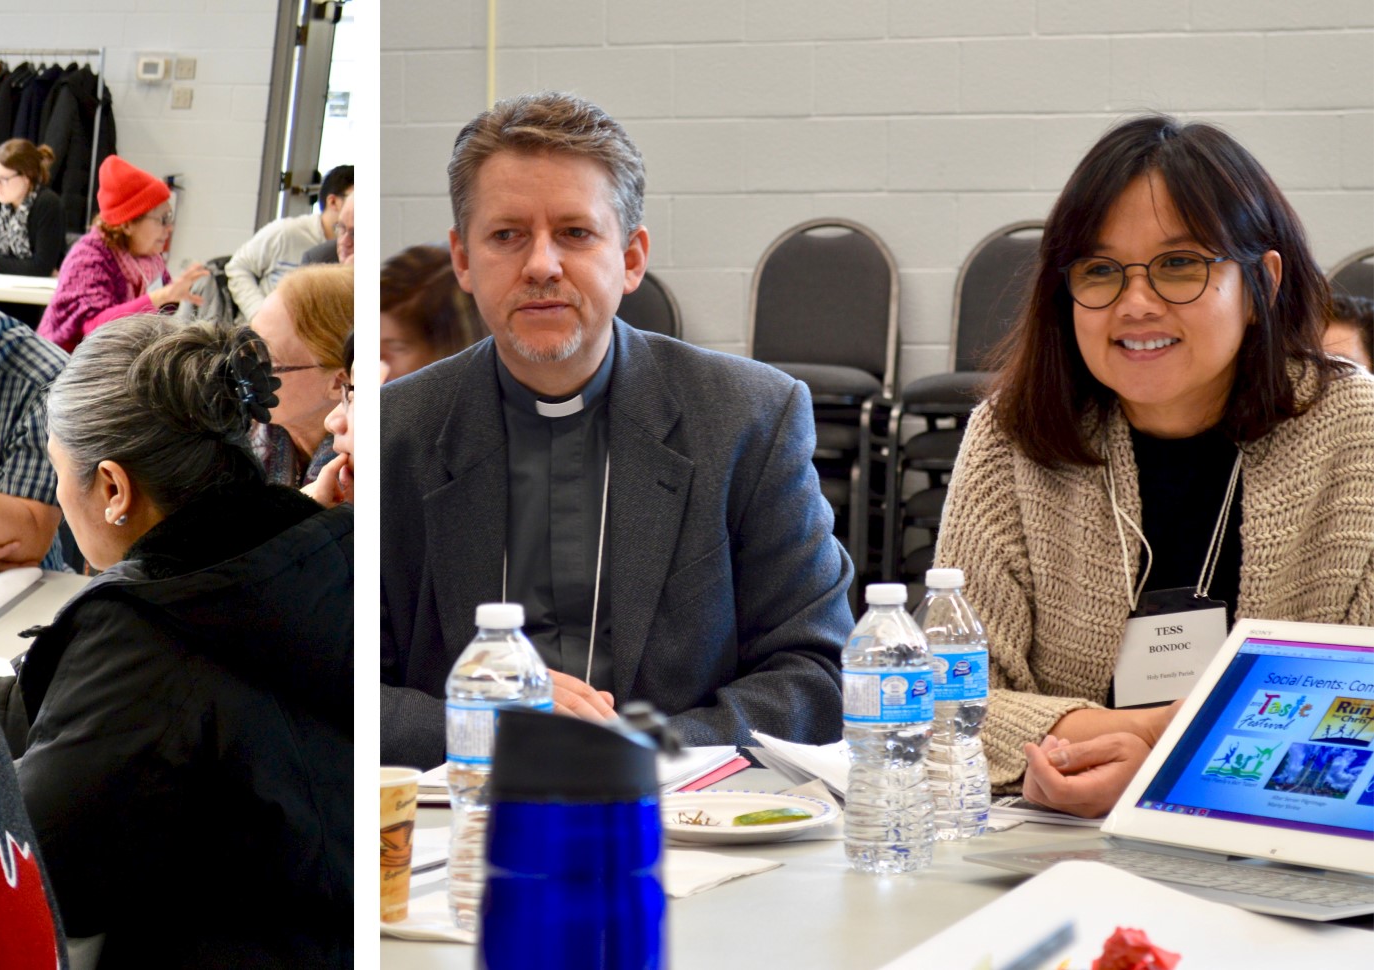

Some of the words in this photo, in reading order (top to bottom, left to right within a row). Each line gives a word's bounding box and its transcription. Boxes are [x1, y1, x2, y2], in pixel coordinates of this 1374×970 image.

[1155, 625, 1184, 637] TESS
[1149, 642, 1192, 654] BONDOC
[1264, 672, 1303, 686] Social
[1302, 675, 1348, 690] Events:
[1258, 692, 1313, 719] Taste
[1335, 701, 1373, 716] Run
